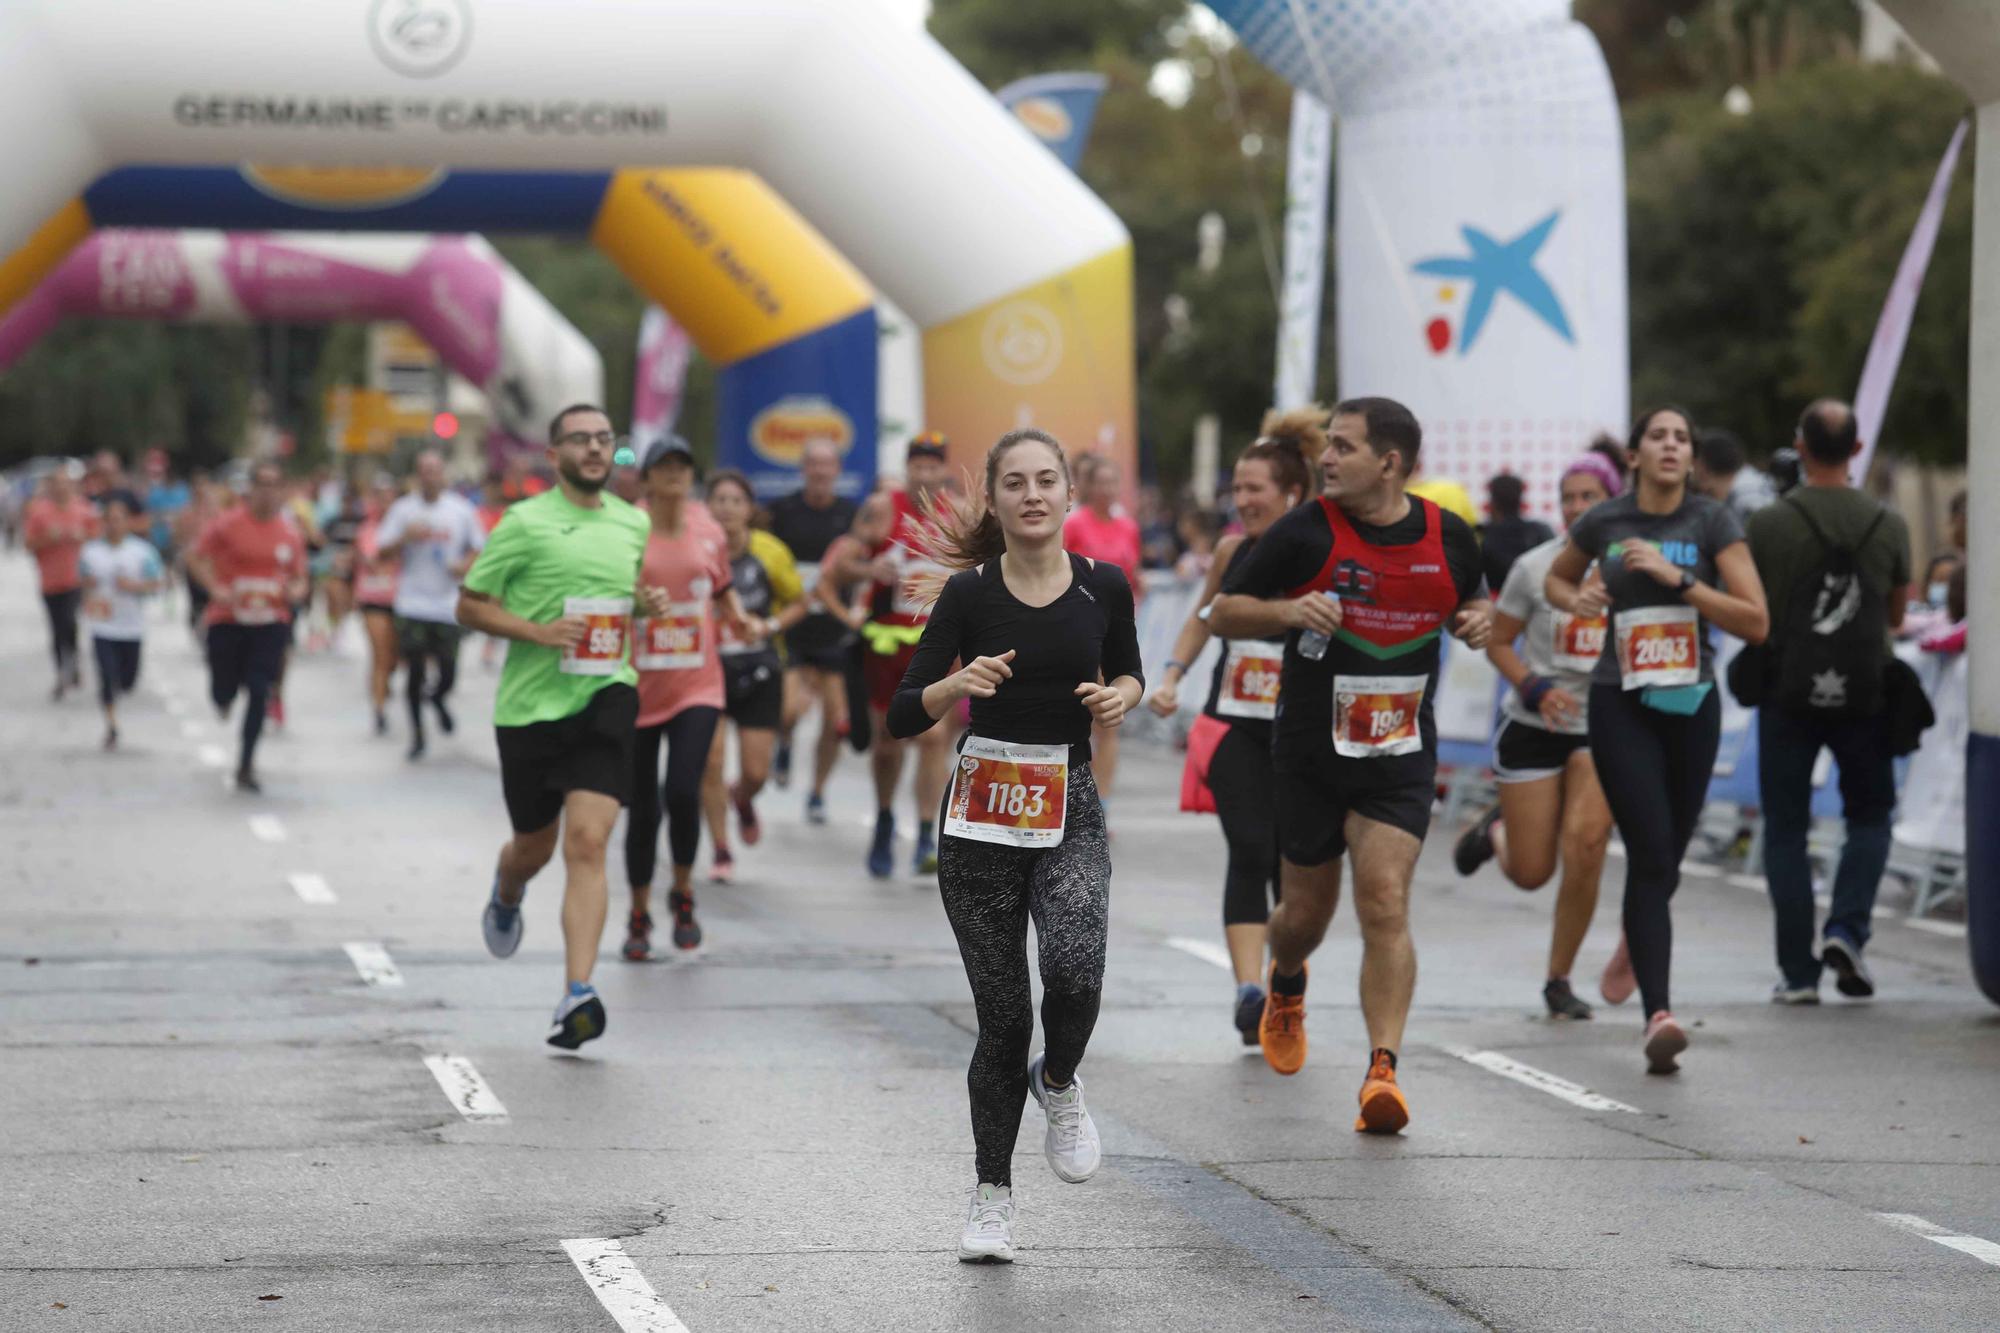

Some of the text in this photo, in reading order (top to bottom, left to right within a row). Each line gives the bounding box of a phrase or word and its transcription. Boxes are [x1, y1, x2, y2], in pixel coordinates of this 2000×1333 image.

[174, 95, 396, 129] GERMAINE
[436, 96, 667, 135] CAPUCCINI
[1634, 636, 1688, 665] 2093
[987, 782, 1047, 817] 1183
